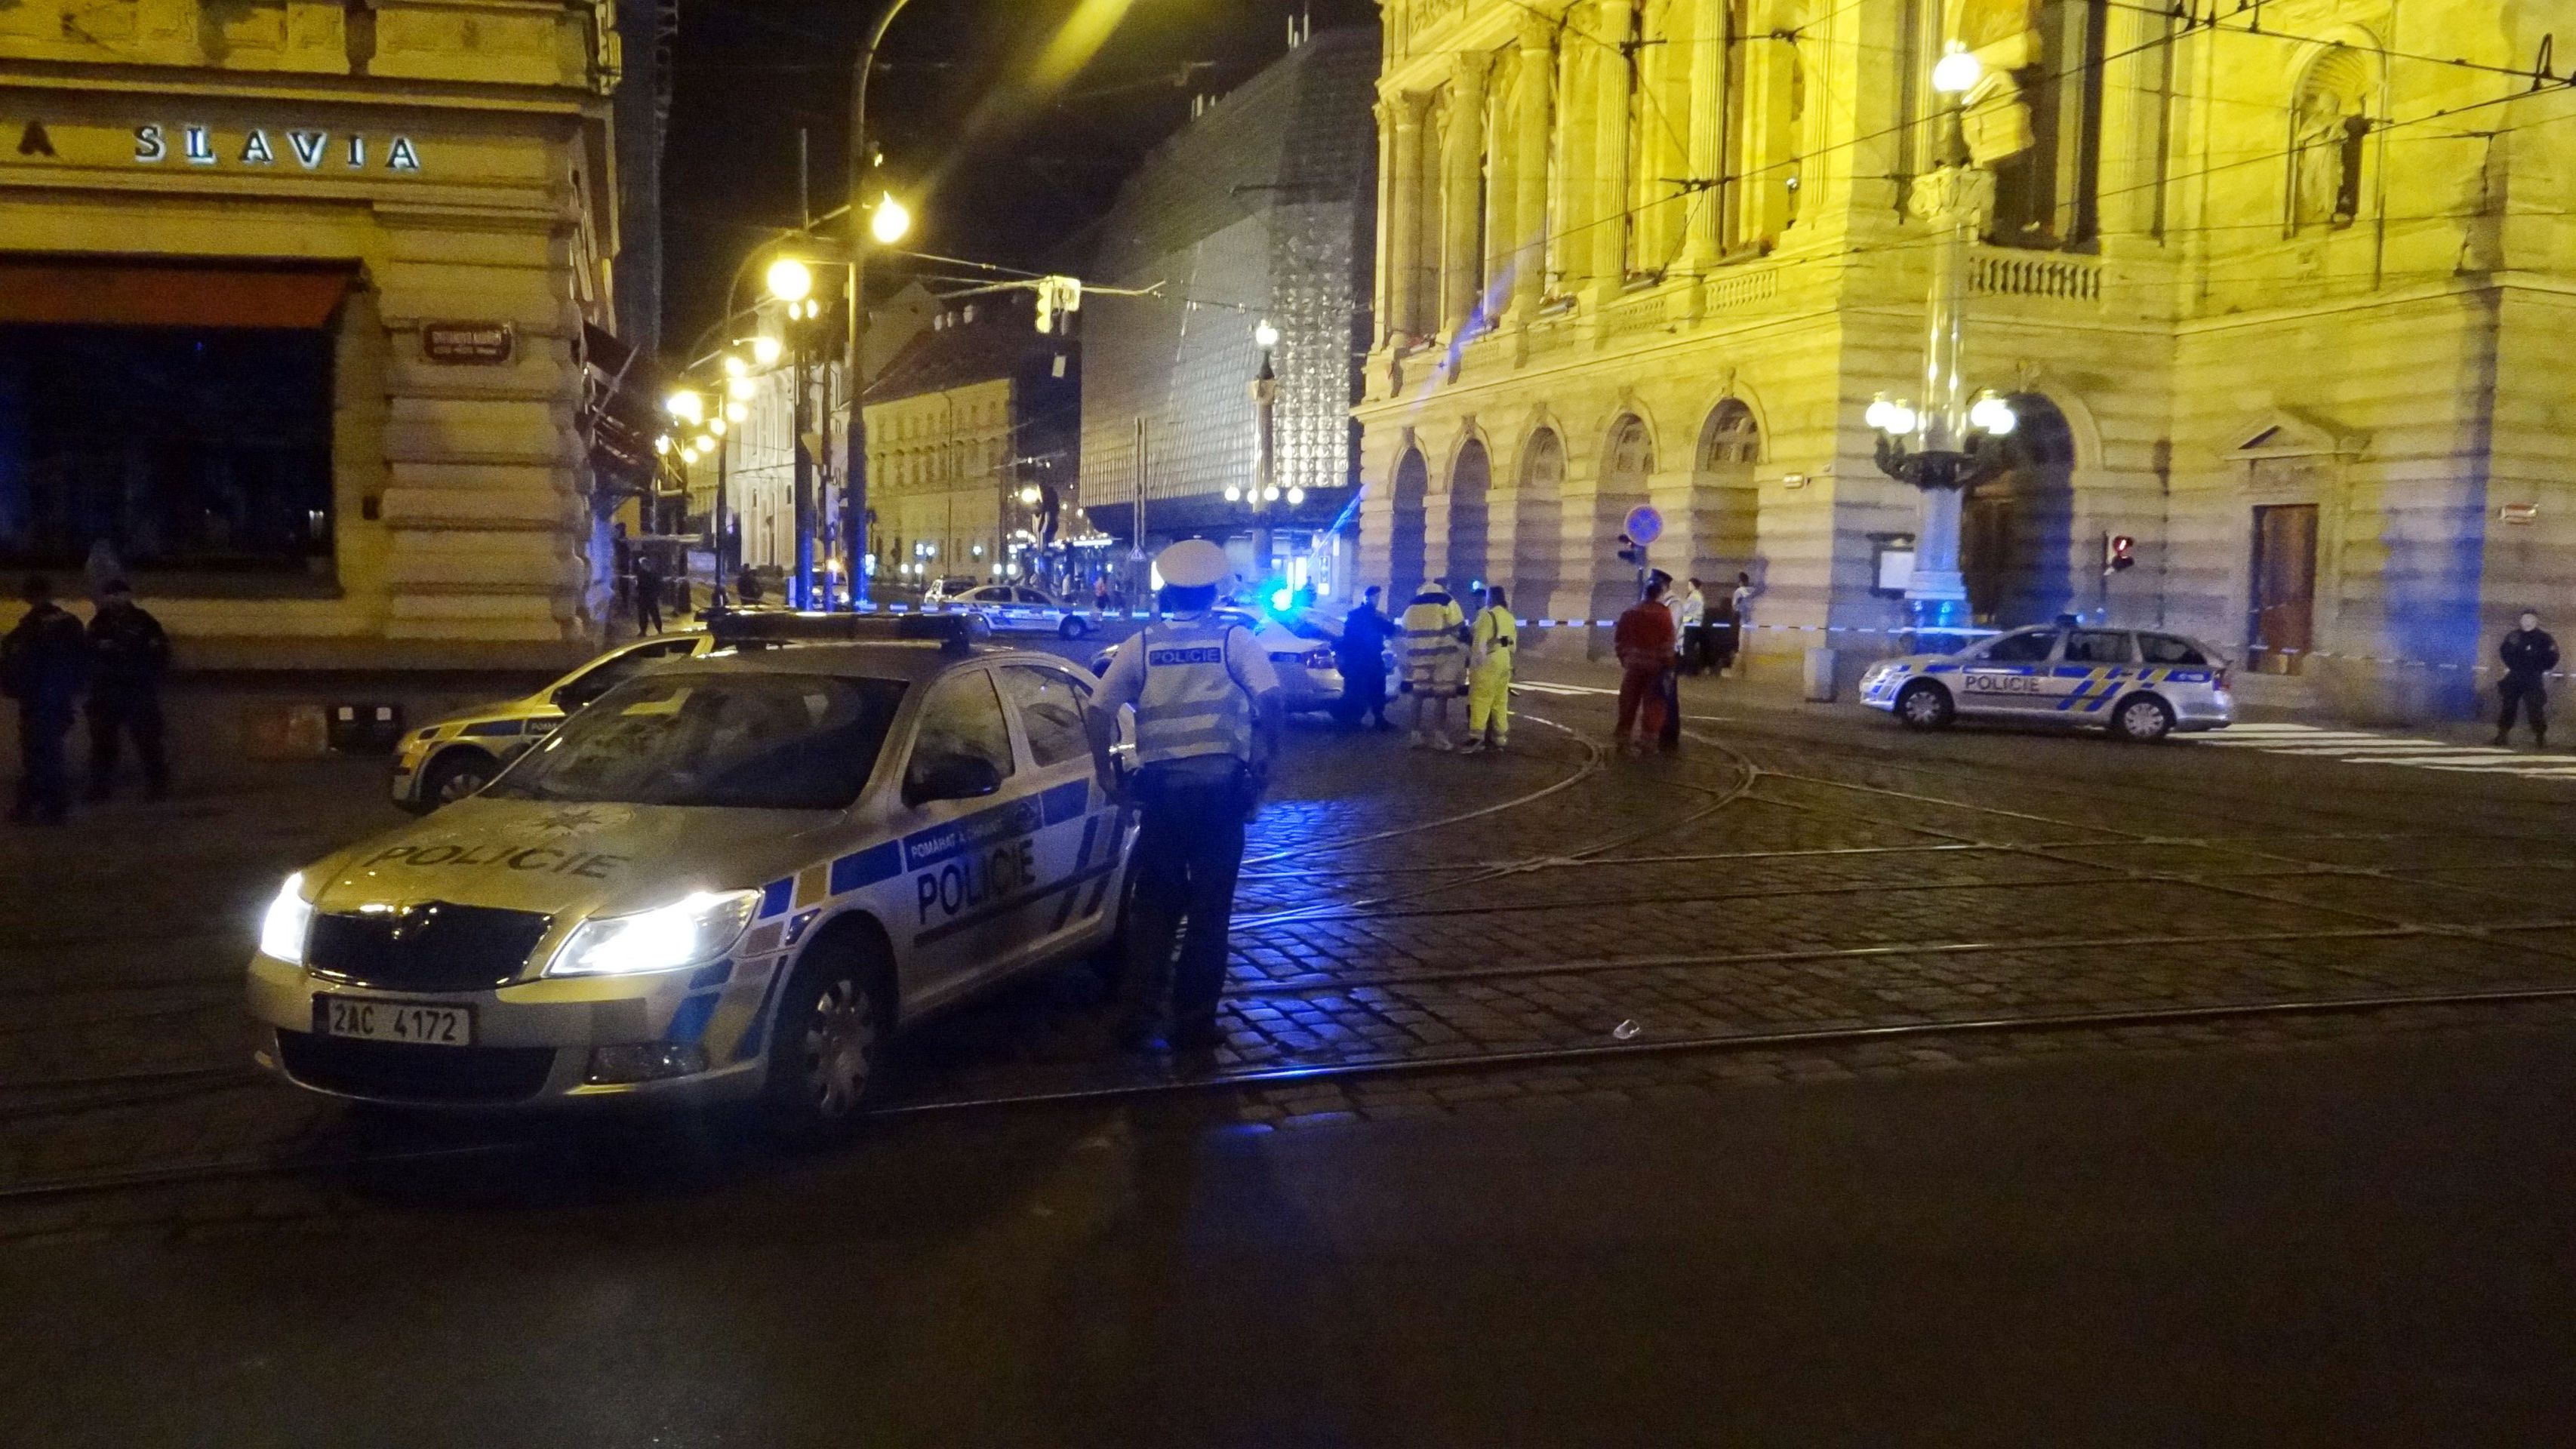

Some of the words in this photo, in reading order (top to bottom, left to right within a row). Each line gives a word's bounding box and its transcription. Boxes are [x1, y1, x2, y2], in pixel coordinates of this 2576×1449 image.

[134, 124, 420, 171] SLAVIA
[1152, 648, 1220, 664] POLICIE
[1965, 675, 2039, 692] POLICIE
[362, 844, 629, 878] POLICIE
[918, 839, 1036, 924] POLICIE
[333, 1003, 375, 1035] 2AC
[393, 1009, 457, 1041] 4172
